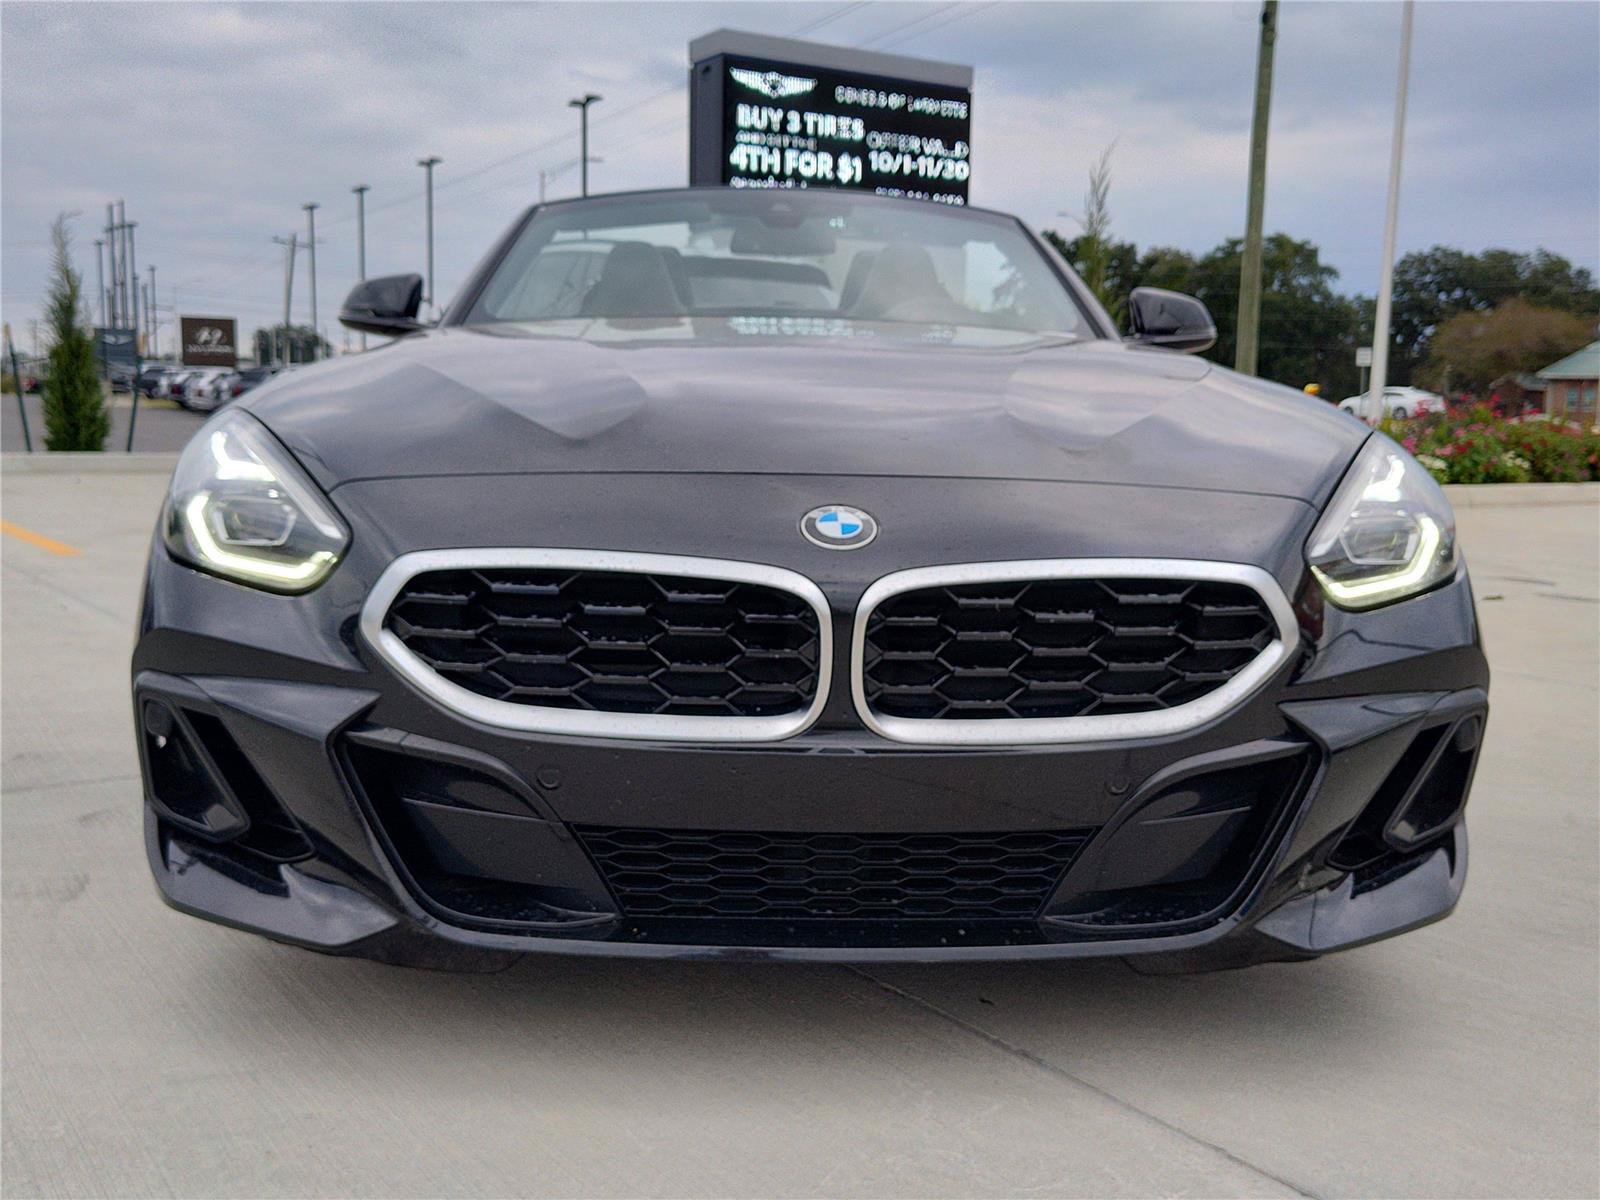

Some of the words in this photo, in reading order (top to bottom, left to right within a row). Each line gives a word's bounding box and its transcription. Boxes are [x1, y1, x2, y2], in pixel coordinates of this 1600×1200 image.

[736, 103, 783, 132] BUY
[786, 109, 801, 133] 3
[803, 111, 865, 140] TIRES
[729, 143, 781, 174] 4TH
[783, 148, 834, 180] FOR
[837, 151, 863, 184] $1
[869, 150, 969, 180] 10/1-11/30
